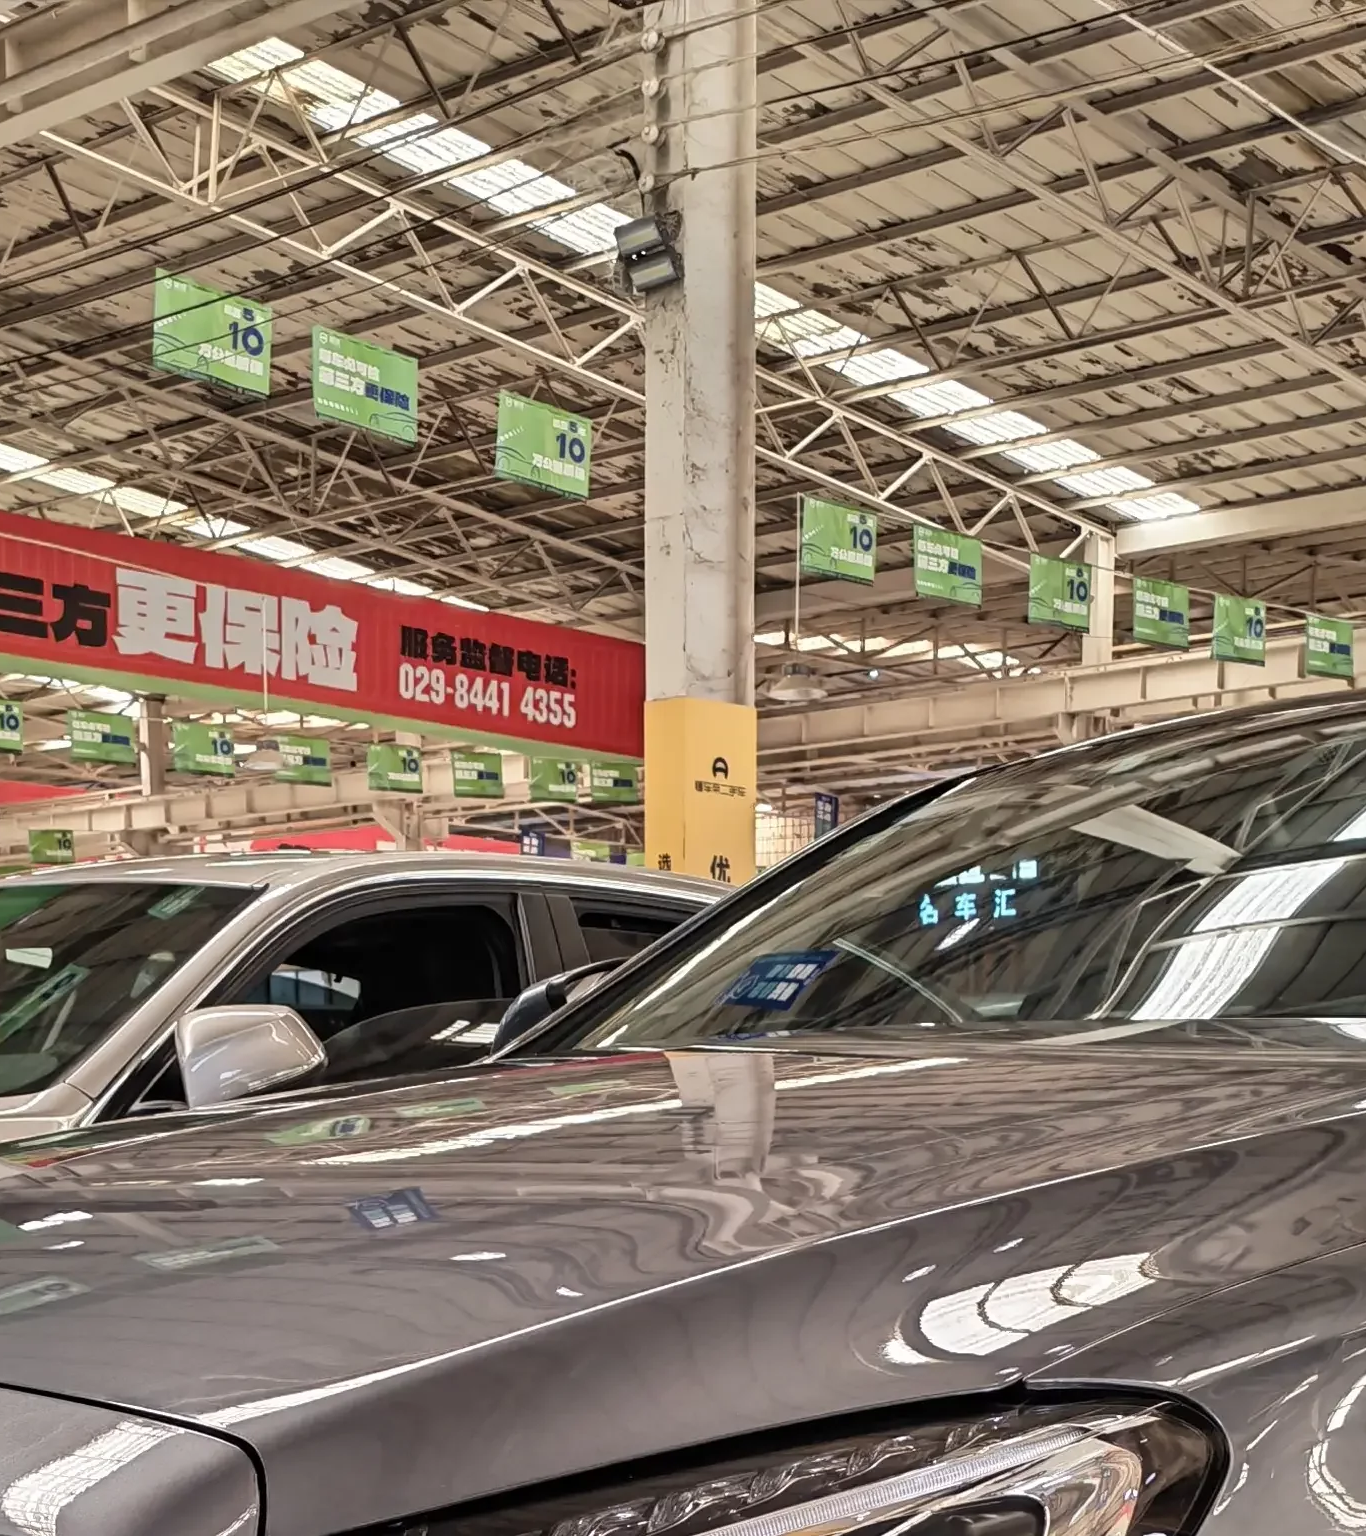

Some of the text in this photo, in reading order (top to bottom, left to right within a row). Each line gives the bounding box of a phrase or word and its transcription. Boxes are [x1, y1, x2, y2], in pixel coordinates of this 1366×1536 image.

[228, 321, 265, 357] 10
[556, 432, 585, 464] 10
[849, 526, 874, 552] 10
[1066, 578, 1089, 602] 10
[1246, 616, 1264, 638] 10
[399, 663, 577, 728] 029-8441 4355
[211, 738, 233, 756] 10
[401, 758, 419, 774] 10
[559, 767, 577, 784] 10
[57, 838, 72, 850] 10
